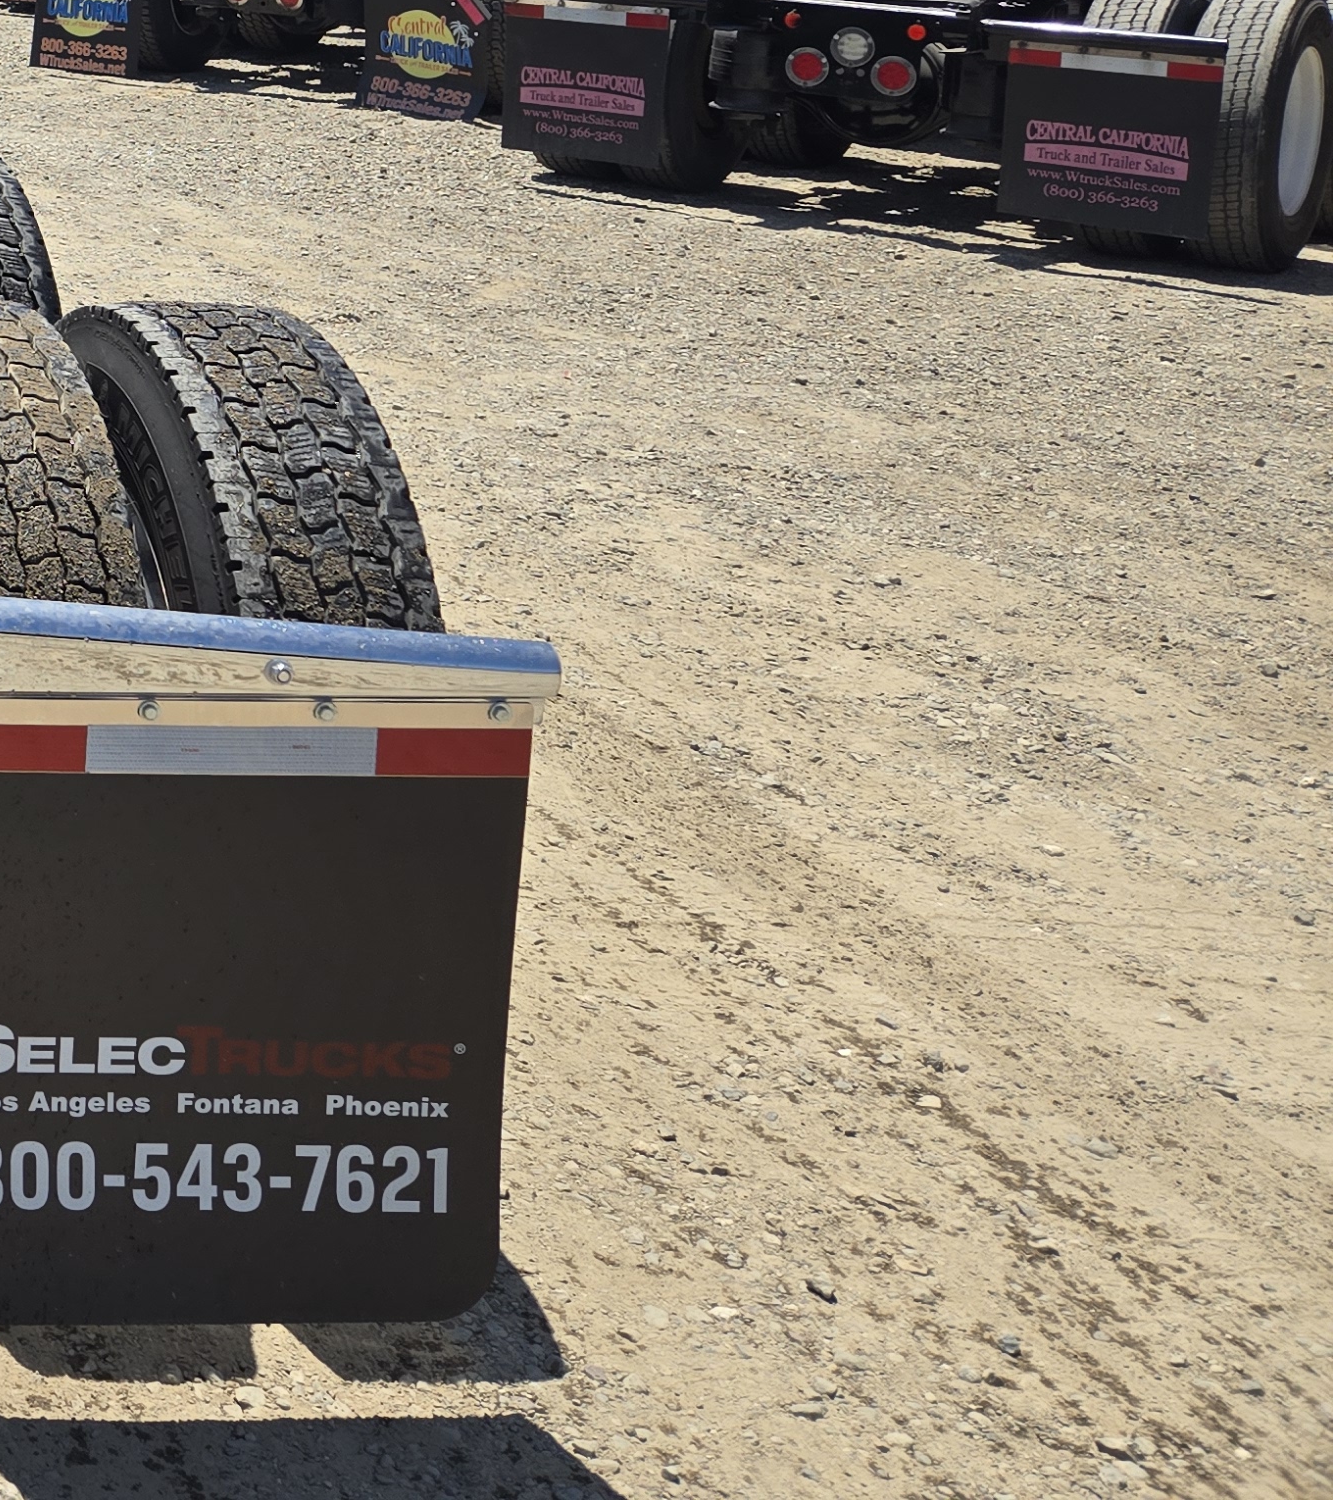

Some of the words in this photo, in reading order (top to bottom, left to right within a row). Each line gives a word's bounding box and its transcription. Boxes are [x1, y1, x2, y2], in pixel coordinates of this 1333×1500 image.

[388, 16, 446, 37] Central
[41, 37, 127, 60] 800-366-3263
[380, 30, 472, 68] CALIFORNIA
[40, 53, 126, 75] WTruckSales.net
[371, 76, 471, 107] 800-366-3263
[521, 66, 574, 84] CENTRAL
[576, 72, 645, 98] CALIFORNIA
[366, 92, 464, 118] WTruckSales.net
[530, 90, 558, 100] Truck
[560, 92, 575, 104] and
[578, 94, 609, 108] Trailer
[611, 98, 635, 111] Sales
[523, 109, 639, 130] www.WtruckSales.com
[536, 121, 567, 136] (800)
[569, 128, 623, 144] 366-3263
[1026, 120, 1095, 143] CENTRAL
[1099, 128, 1189, 160] CALIFORNIA
[1036, 147, 1071, 161] Truck
[1074, 152, 1096, 165] and
[1100, 153, 1141, 170] Trailer
[1144, 160, 1175, 175] Sales
[1027, 168, 1180, 195] www.WtruckSales.com
[1043, 183, 1084, 200] (800)
[1087, 191, 1158, 211] 366-3263
[28, 1091, 151, 1117] Angeles
[177, 1092, 299, 1115] Fontana
[325, 1095, 449, 1118] Phoenix
